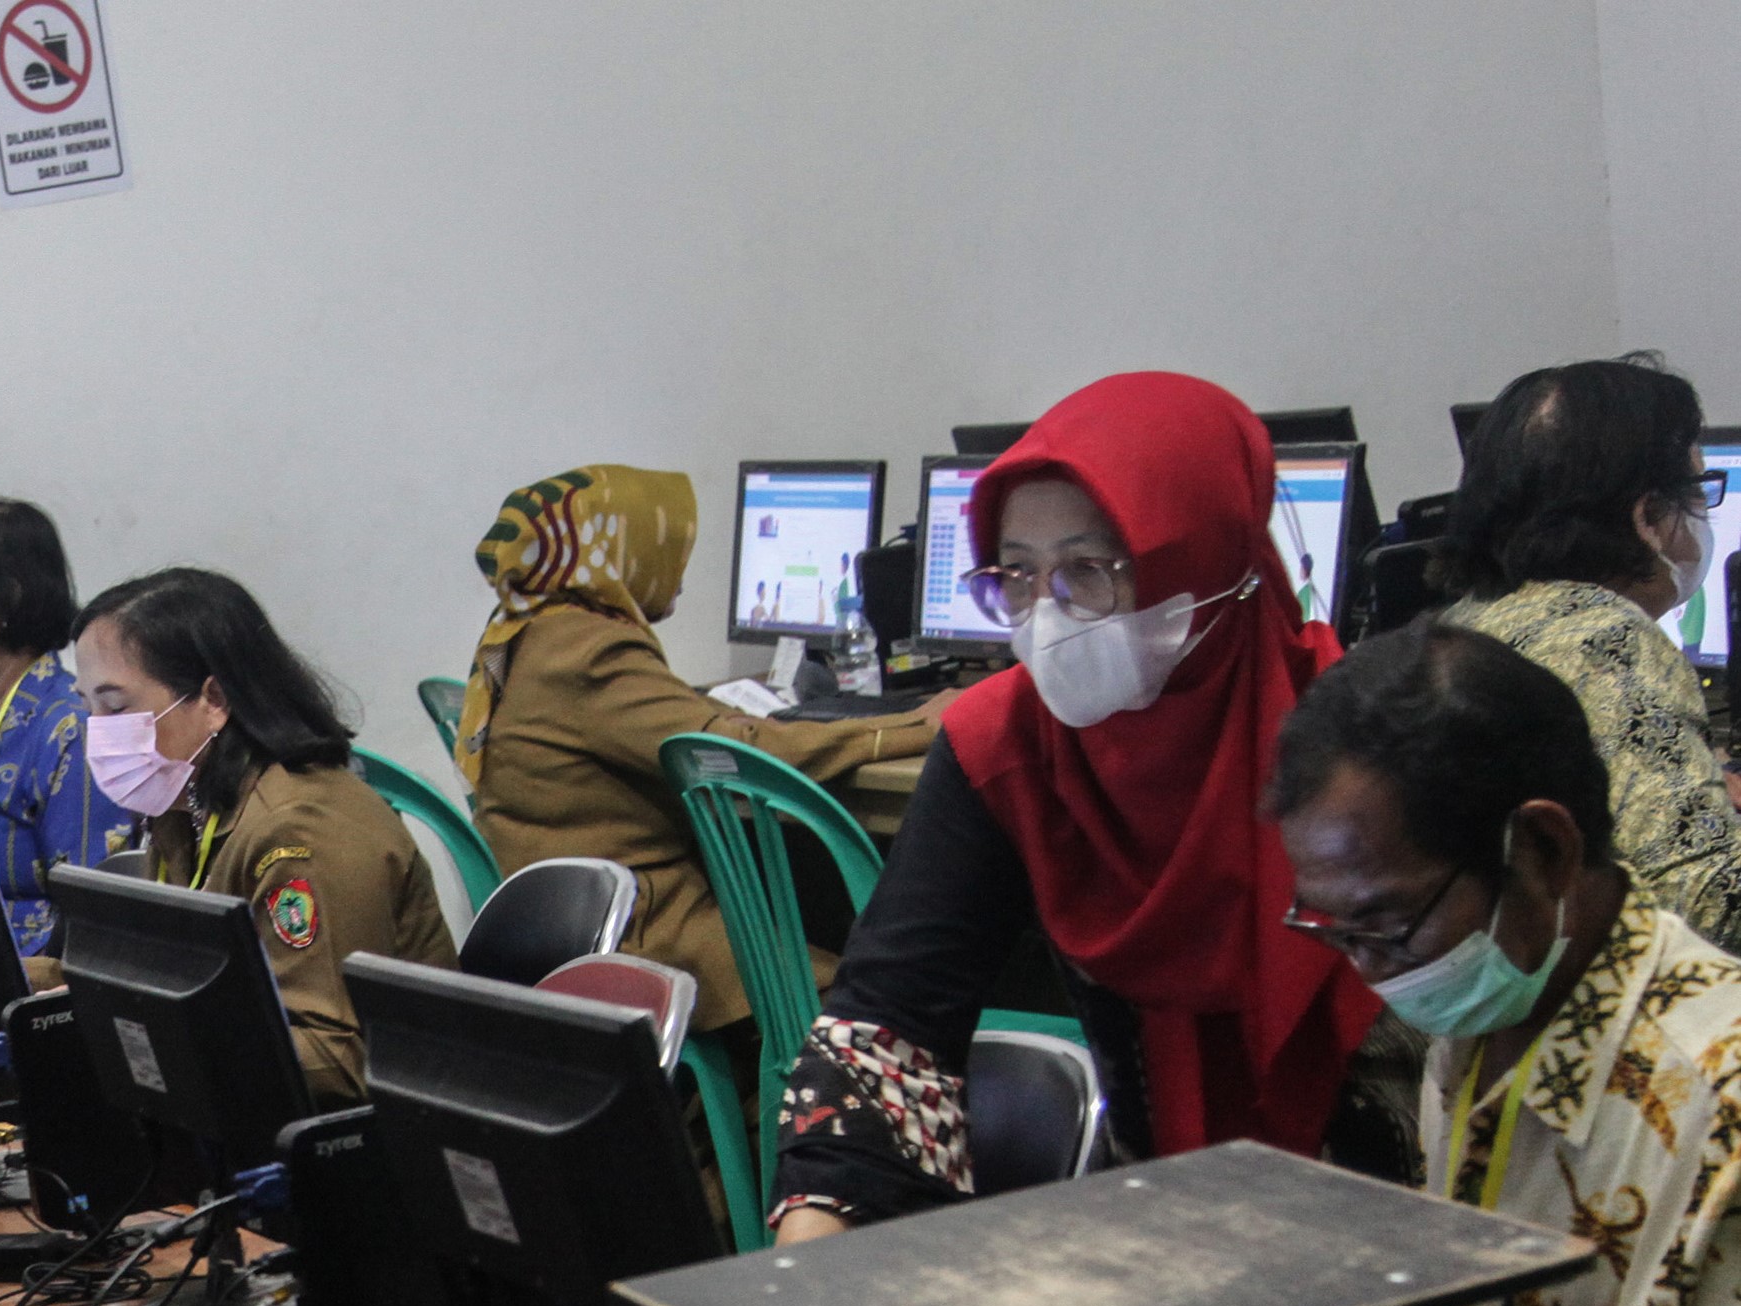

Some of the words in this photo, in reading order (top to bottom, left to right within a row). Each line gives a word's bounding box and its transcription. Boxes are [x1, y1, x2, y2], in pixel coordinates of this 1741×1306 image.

[5, 126, 57, 147] DILARANG
[58, 118, 107, 137] MEMBAWA
[8, 145, 58, 165] MAKANAN
[65, 136, 112, 154] MINUMAN
[38, 165, 61, 180] DARI
[63, 160, 89, 176] LUAR
[31, 1010, 75, 1031] zyrex
